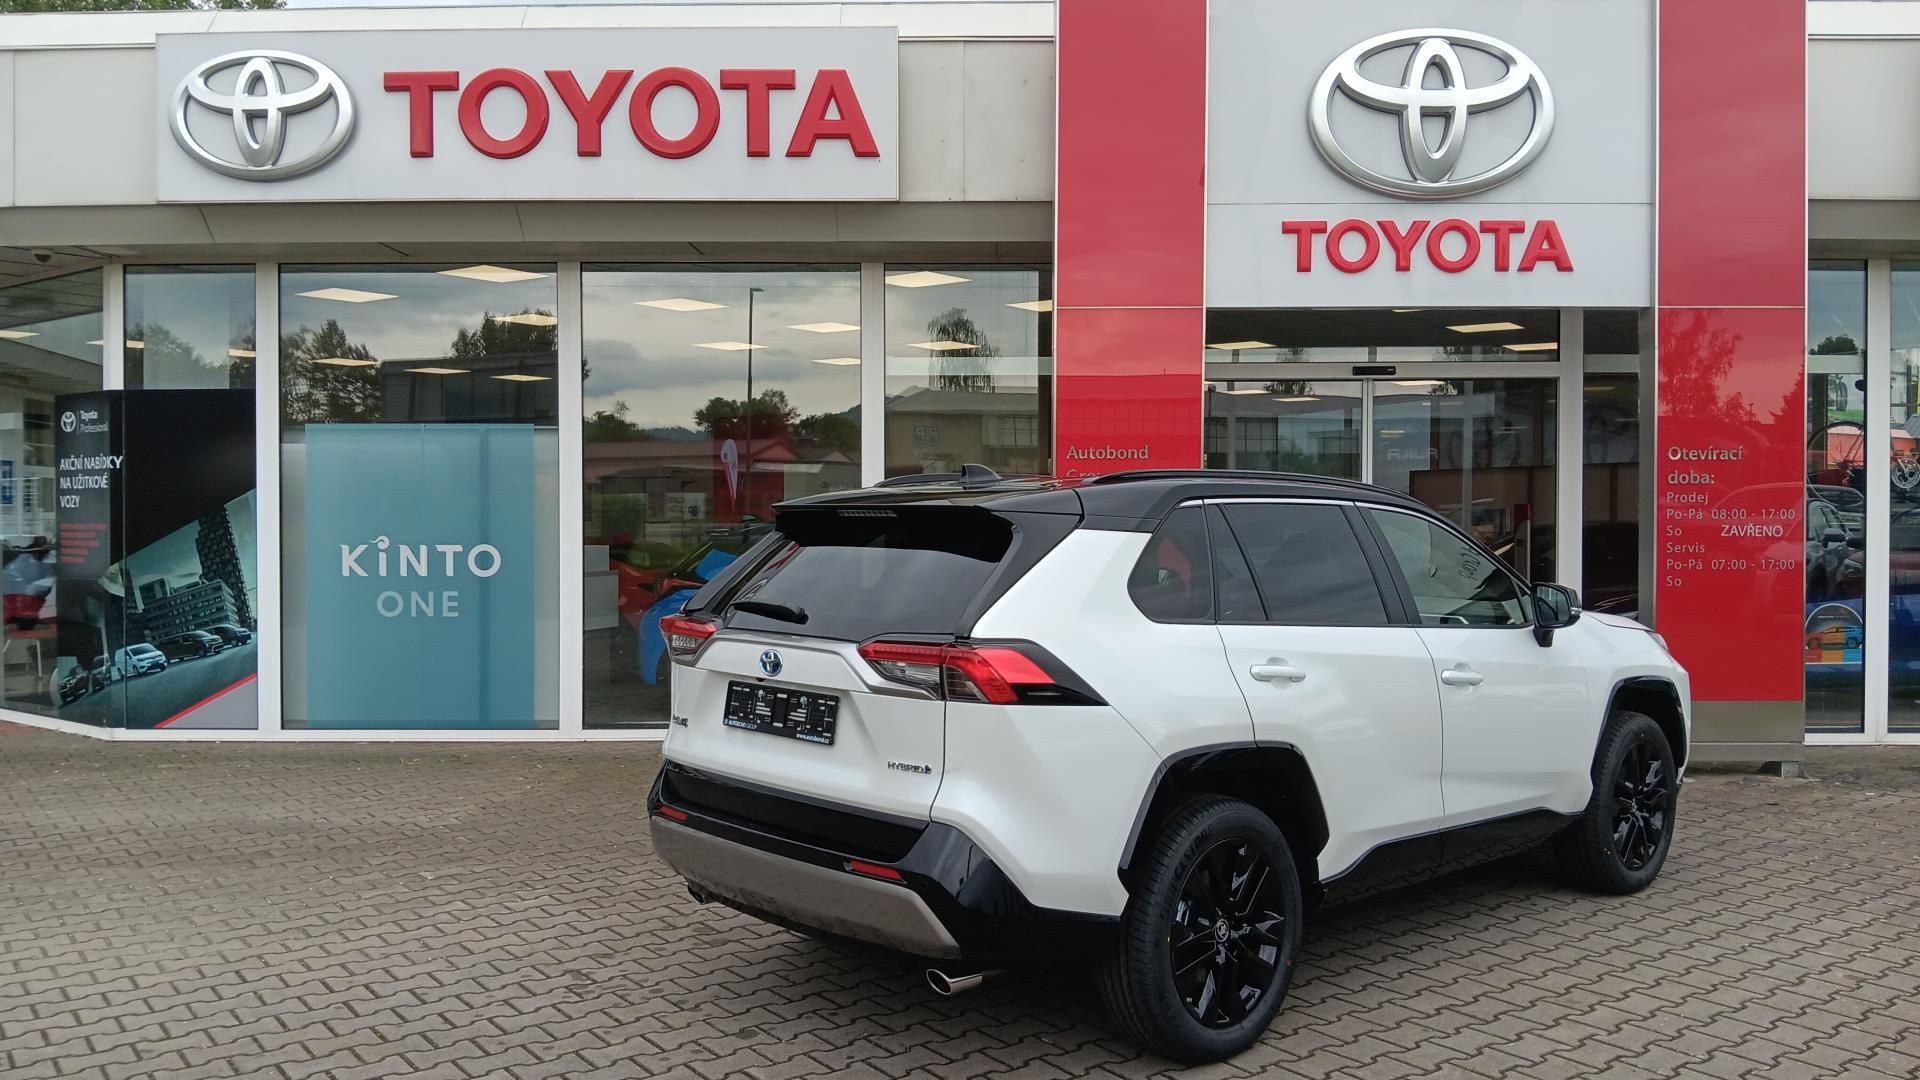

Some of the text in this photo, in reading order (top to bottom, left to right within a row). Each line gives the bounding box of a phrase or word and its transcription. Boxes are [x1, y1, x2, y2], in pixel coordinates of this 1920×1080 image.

[384, 66, 881, 160] TOYOTA
[1281, 218, 1574, 273] TOYOTA
[79, 410, 98, 421] Toyota
[1066, 444, 1149, 459] Autobond
[1667, 445, 1744, 461] Otevírací
[60, 453, 123, 471] AKČNÍ NABÍDKY
[60, 472, 109, 489] NA UŽITKOVÉ
[1668, 470, 1715, 484] doba:
[60, 495, 80, 508] VOZY
[1666, 492, 1709, 505] Prodej
[1666, 508, 1703, 519] Po-Pá
[1711, 509, 1747, 519] 08:00
[1761, 508, 1796, 519] 17:00
[1666, 524, 1784, 537] So ZAVŘENO
[1666, 542, 1705, 553] Servis
[1666, 558, 1703, 570] Po-Pá
[1711, 559, 1747, 570] 07:00
[1761, 559, 1795, 570] 17:00
[1666, 576, 1682, 587] So
[377, 590, 459, 618] ONE
[887, 761, 924, 774] HYBRID
